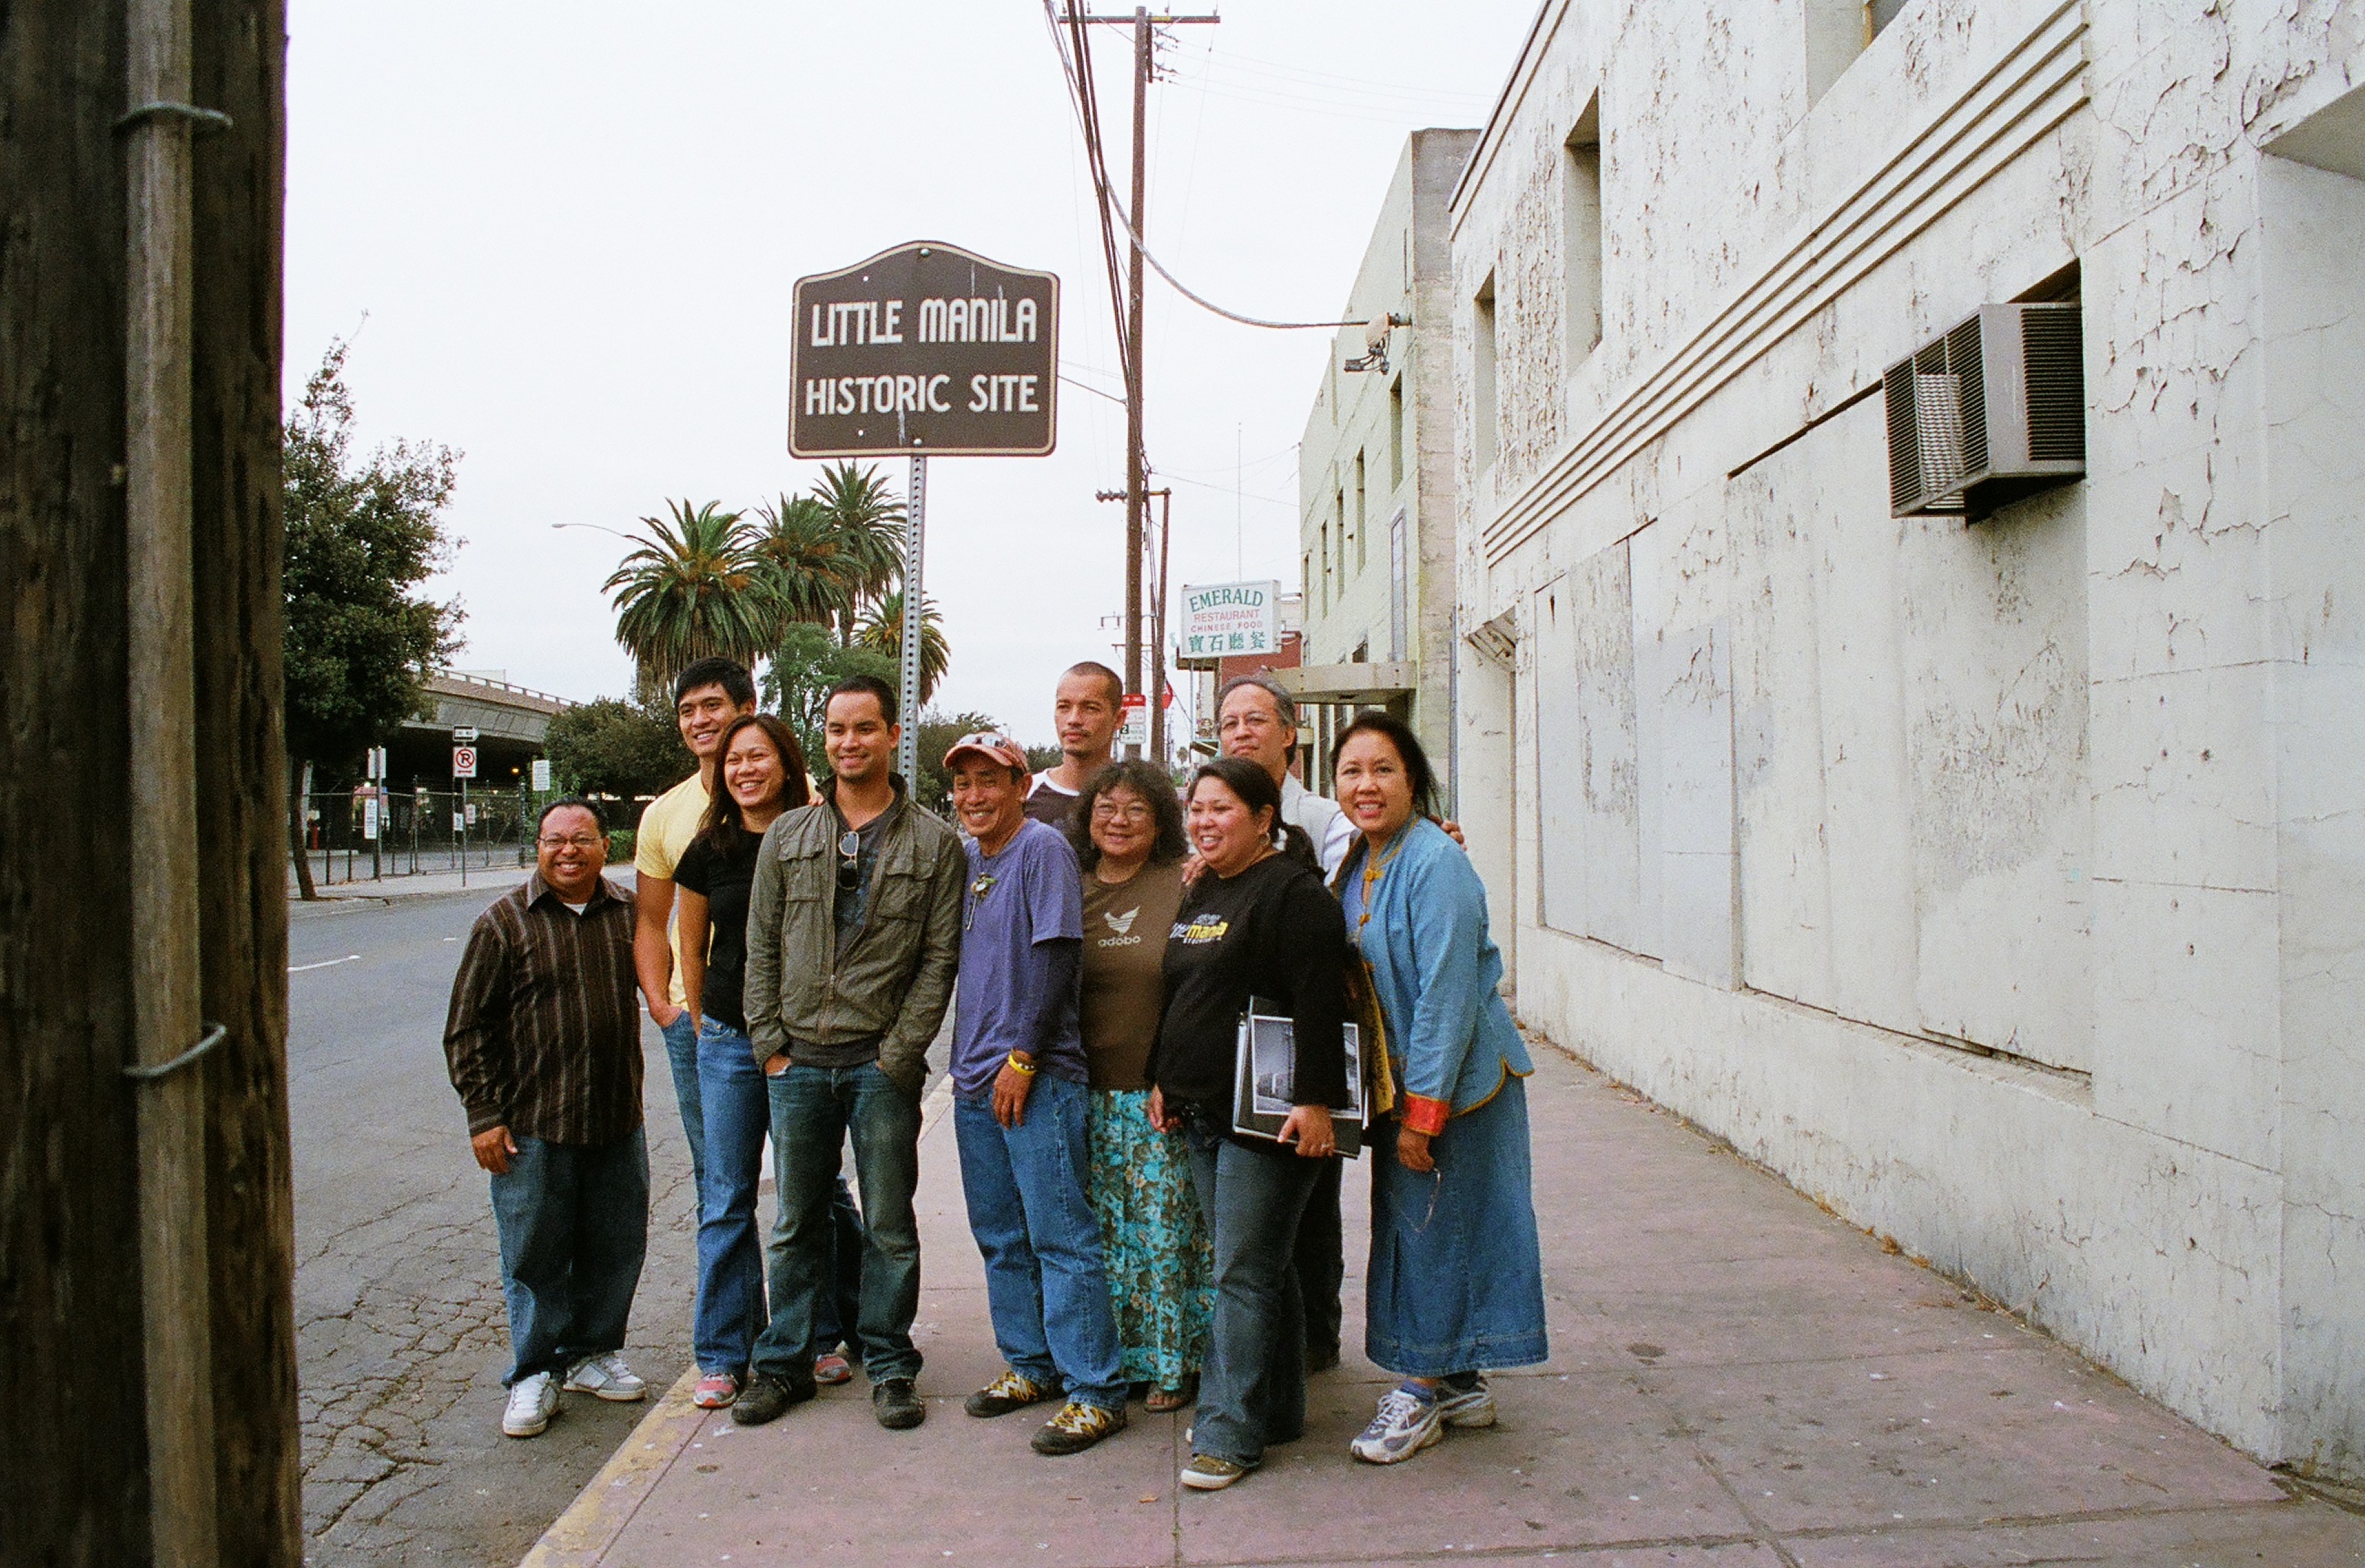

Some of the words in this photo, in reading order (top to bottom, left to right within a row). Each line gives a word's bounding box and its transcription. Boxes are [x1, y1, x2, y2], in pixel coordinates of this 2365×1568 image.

[811, 299, 904, 347] LITTLE
[918, 297, 1038, 343] MANILA
[806, 374, 952, 416] HISTORIC
[968, 374, 1039, 413] SITE
[1189, 588, 1264, 612] EMERALD
[1193, 609, 1261, 624] RESTAURANT
[1190, 623, 1232, 633] CHINESE
[1238, 620, 1263, 629] FOOD
[1122, 725, 1127, 733] 2
[1097, 935, 1141, 948] adobo
